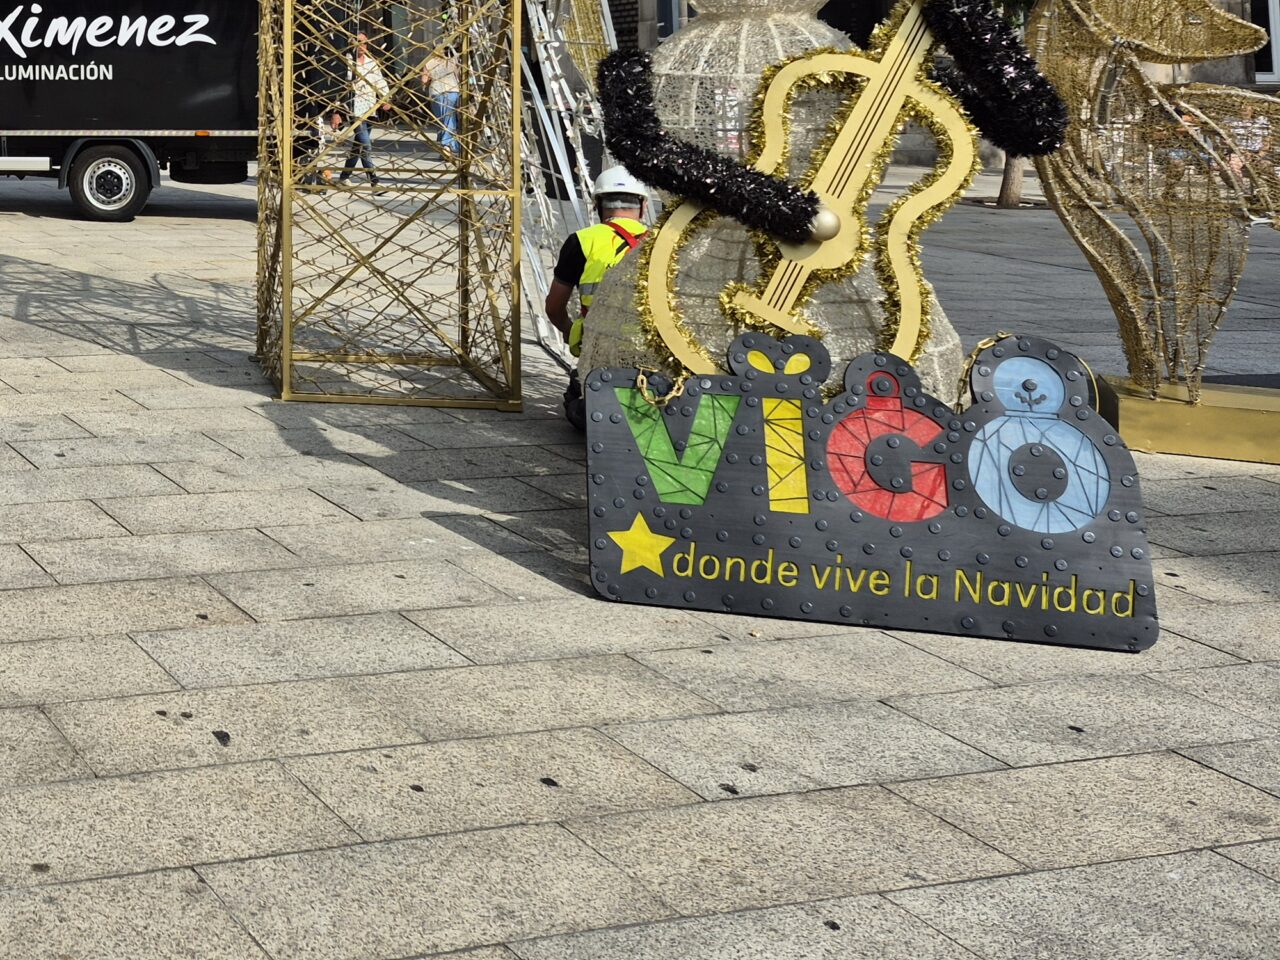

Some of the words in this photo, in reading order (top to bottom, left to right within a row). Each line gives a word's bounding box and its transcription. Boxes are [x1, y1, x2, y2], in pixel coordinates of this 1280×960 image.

[672, 541, 799, 589] donde
[810, 553, 891, 597] vive
[903, 559, 941, 600] la
[953, 568, 1138, 619] Navidad
